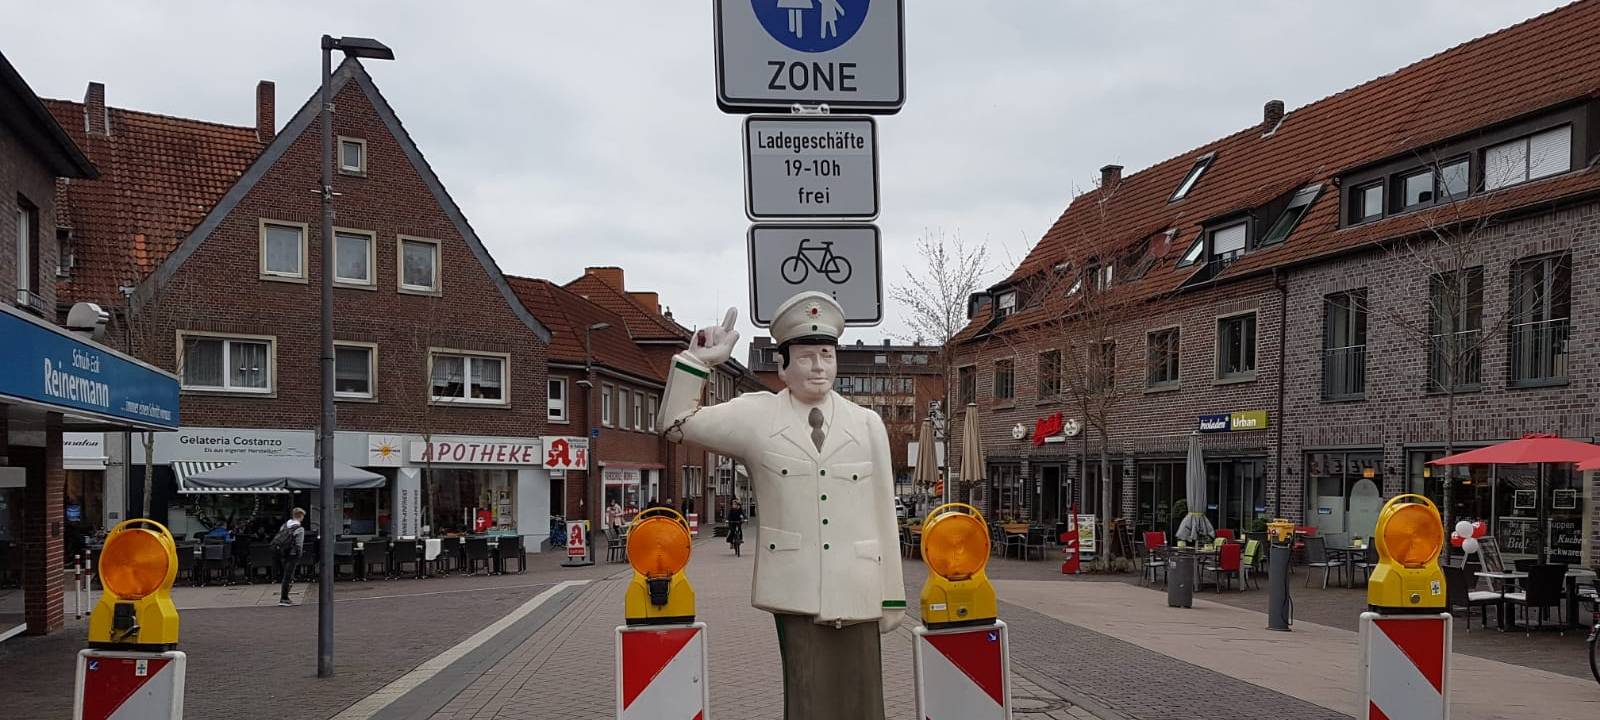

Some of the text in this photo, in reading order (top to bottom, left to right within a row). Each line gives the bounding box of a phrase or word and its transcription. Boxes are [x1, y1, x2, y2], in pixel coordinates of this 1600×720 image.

[767, 60, 858, 92] ZONE
[757, 131, 865, 154] Ladegeschäfte
[798, 187, 830, 204] frei
[44, 356, 110, 408] Reinermann
[1232, 414, 1257, 428] Urban
[179, 434, 282, 446] Gelateria Costanzo
[421, 441, 534, 463] APOTHEKE
